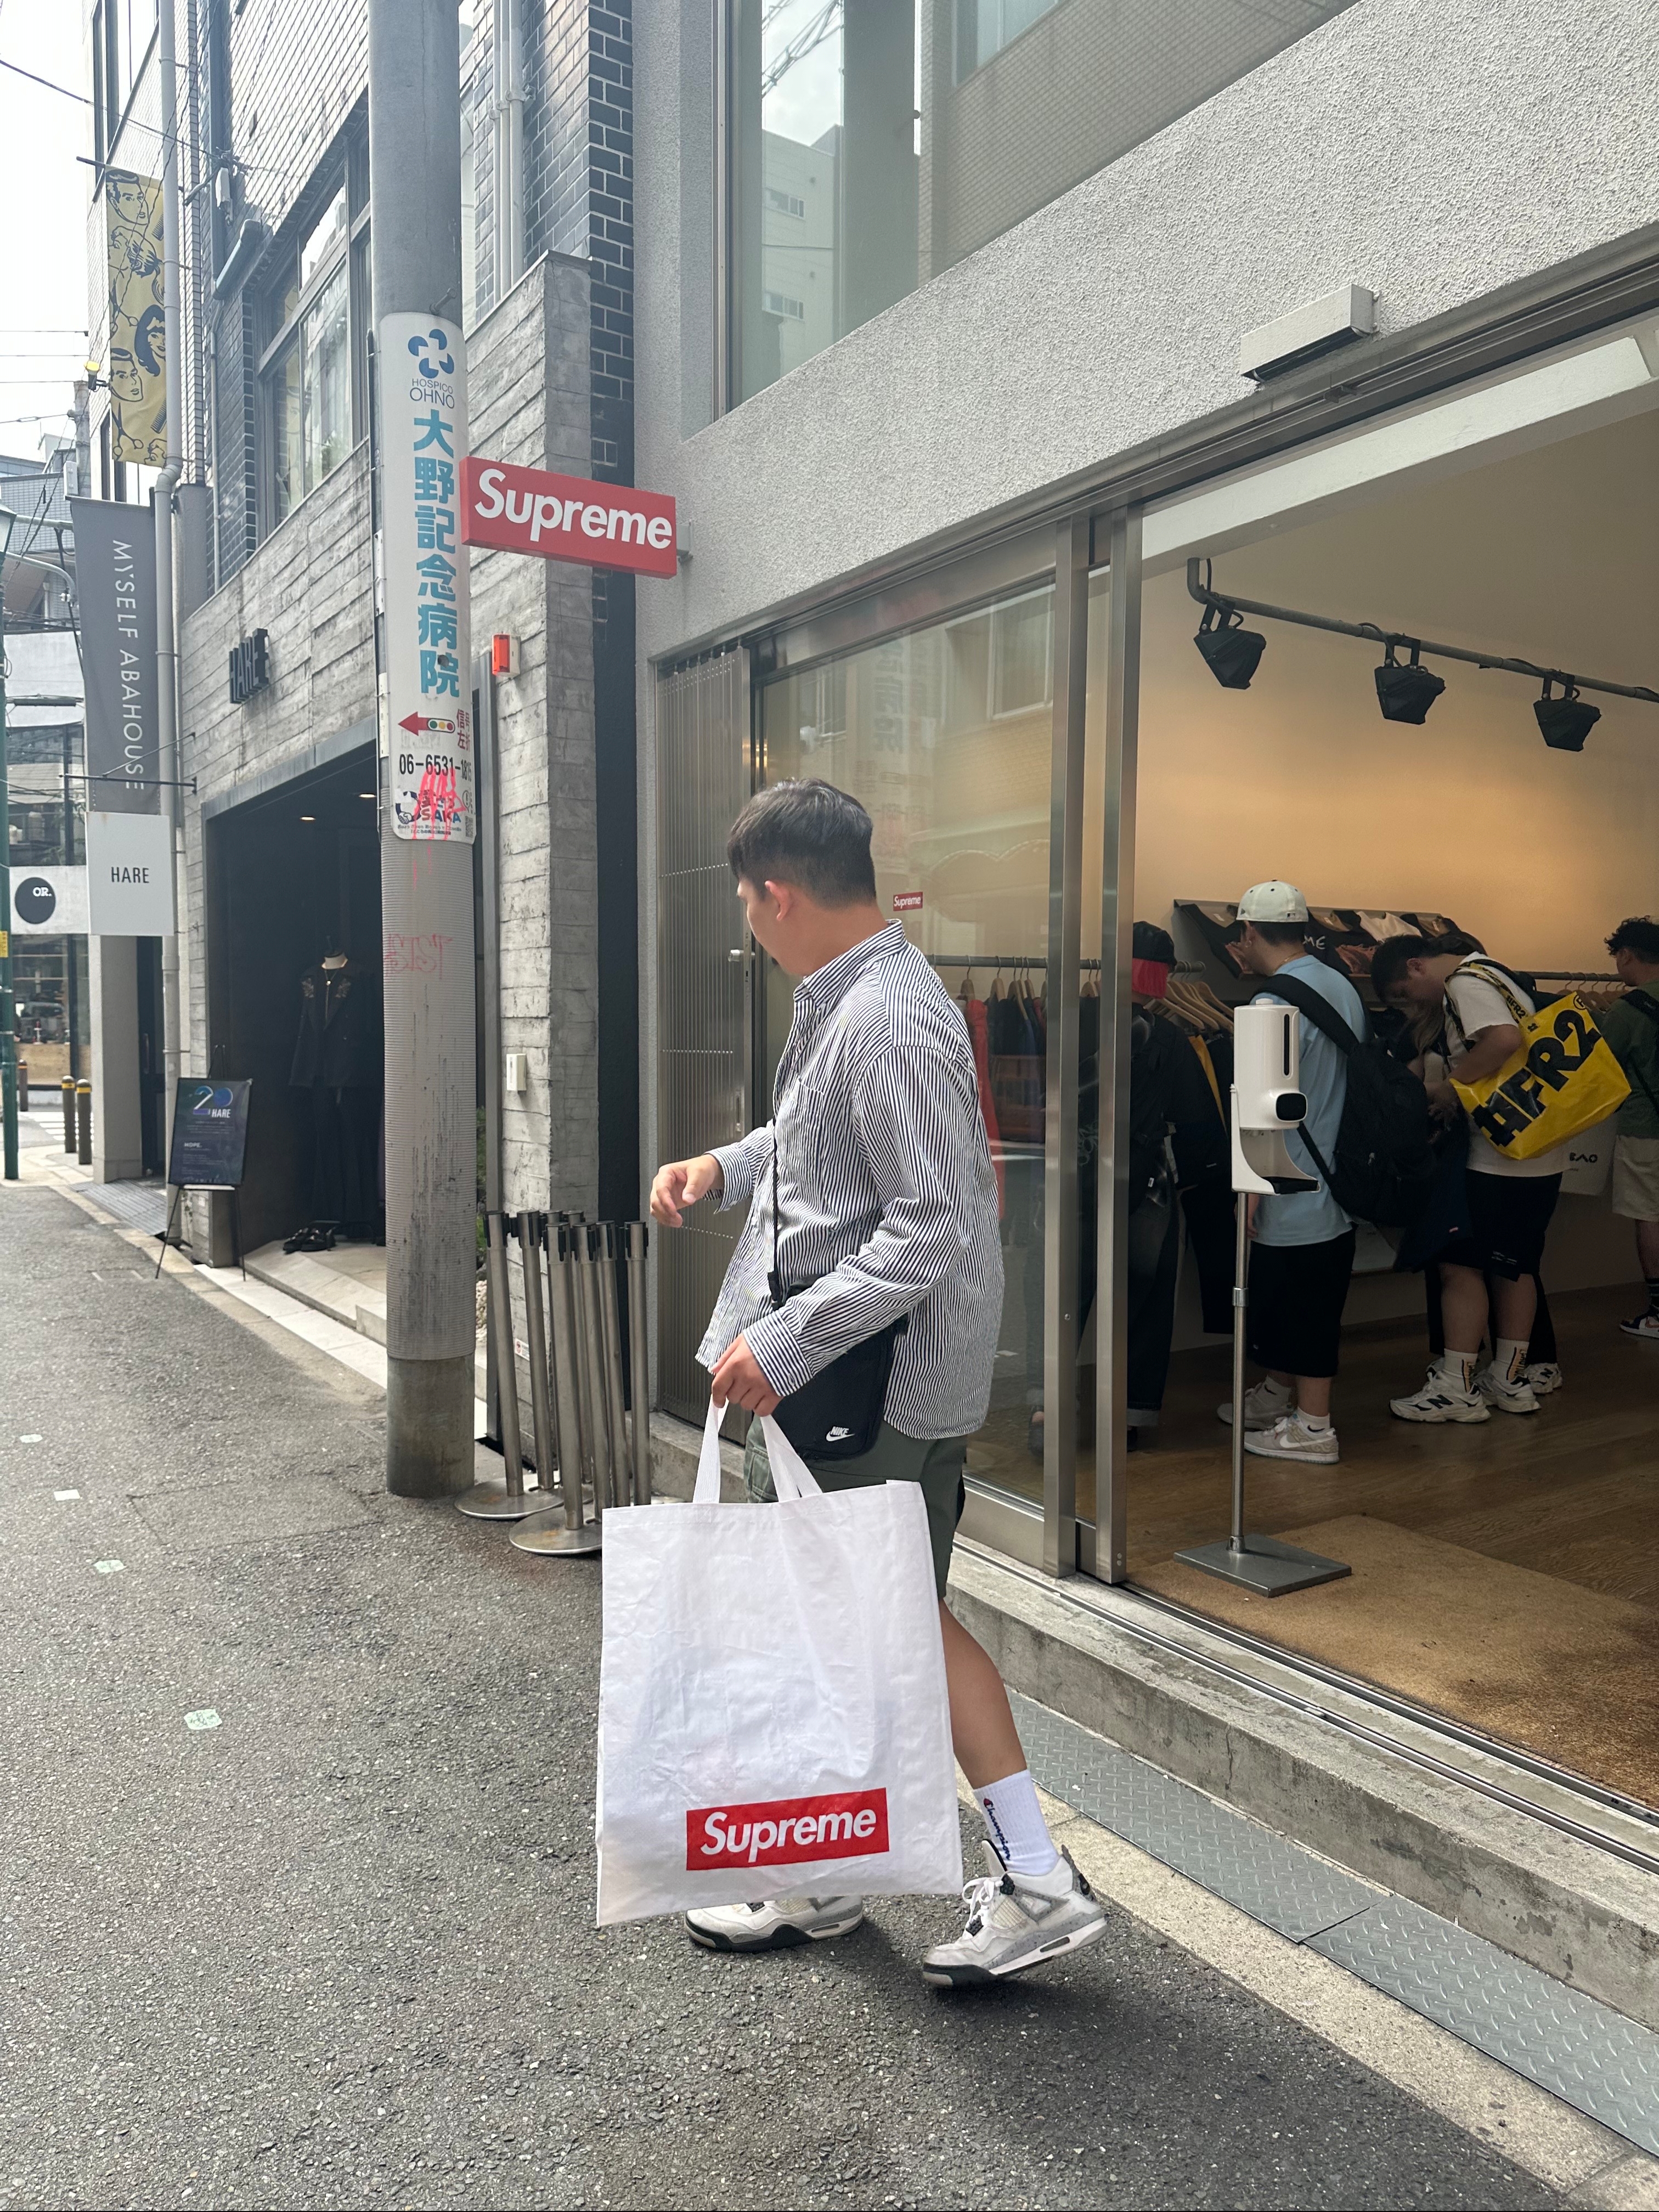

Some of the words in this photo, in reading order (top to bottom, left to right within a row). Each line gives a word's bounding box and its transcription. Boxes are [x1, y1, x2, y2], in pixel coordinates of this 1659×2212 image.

[412, 378, 453, 394] HOSPICO
[410, 387, 455, 409] OHNO
[475, 468, 673, 549] Supreme
[413, 409, 460, 697] 大野記念病院
[111, 866, 150, 883] HARE
[32, 887, 52, 897] OR.
[894, 895, 921, 909] Supreme
[212, 1109, 232, 1119] HARE
[830, 1426, 849, 1436] NIKE
[701, 1808, 877, 1863] Supreme
[983, 1798, 1011, 1860] Champion
